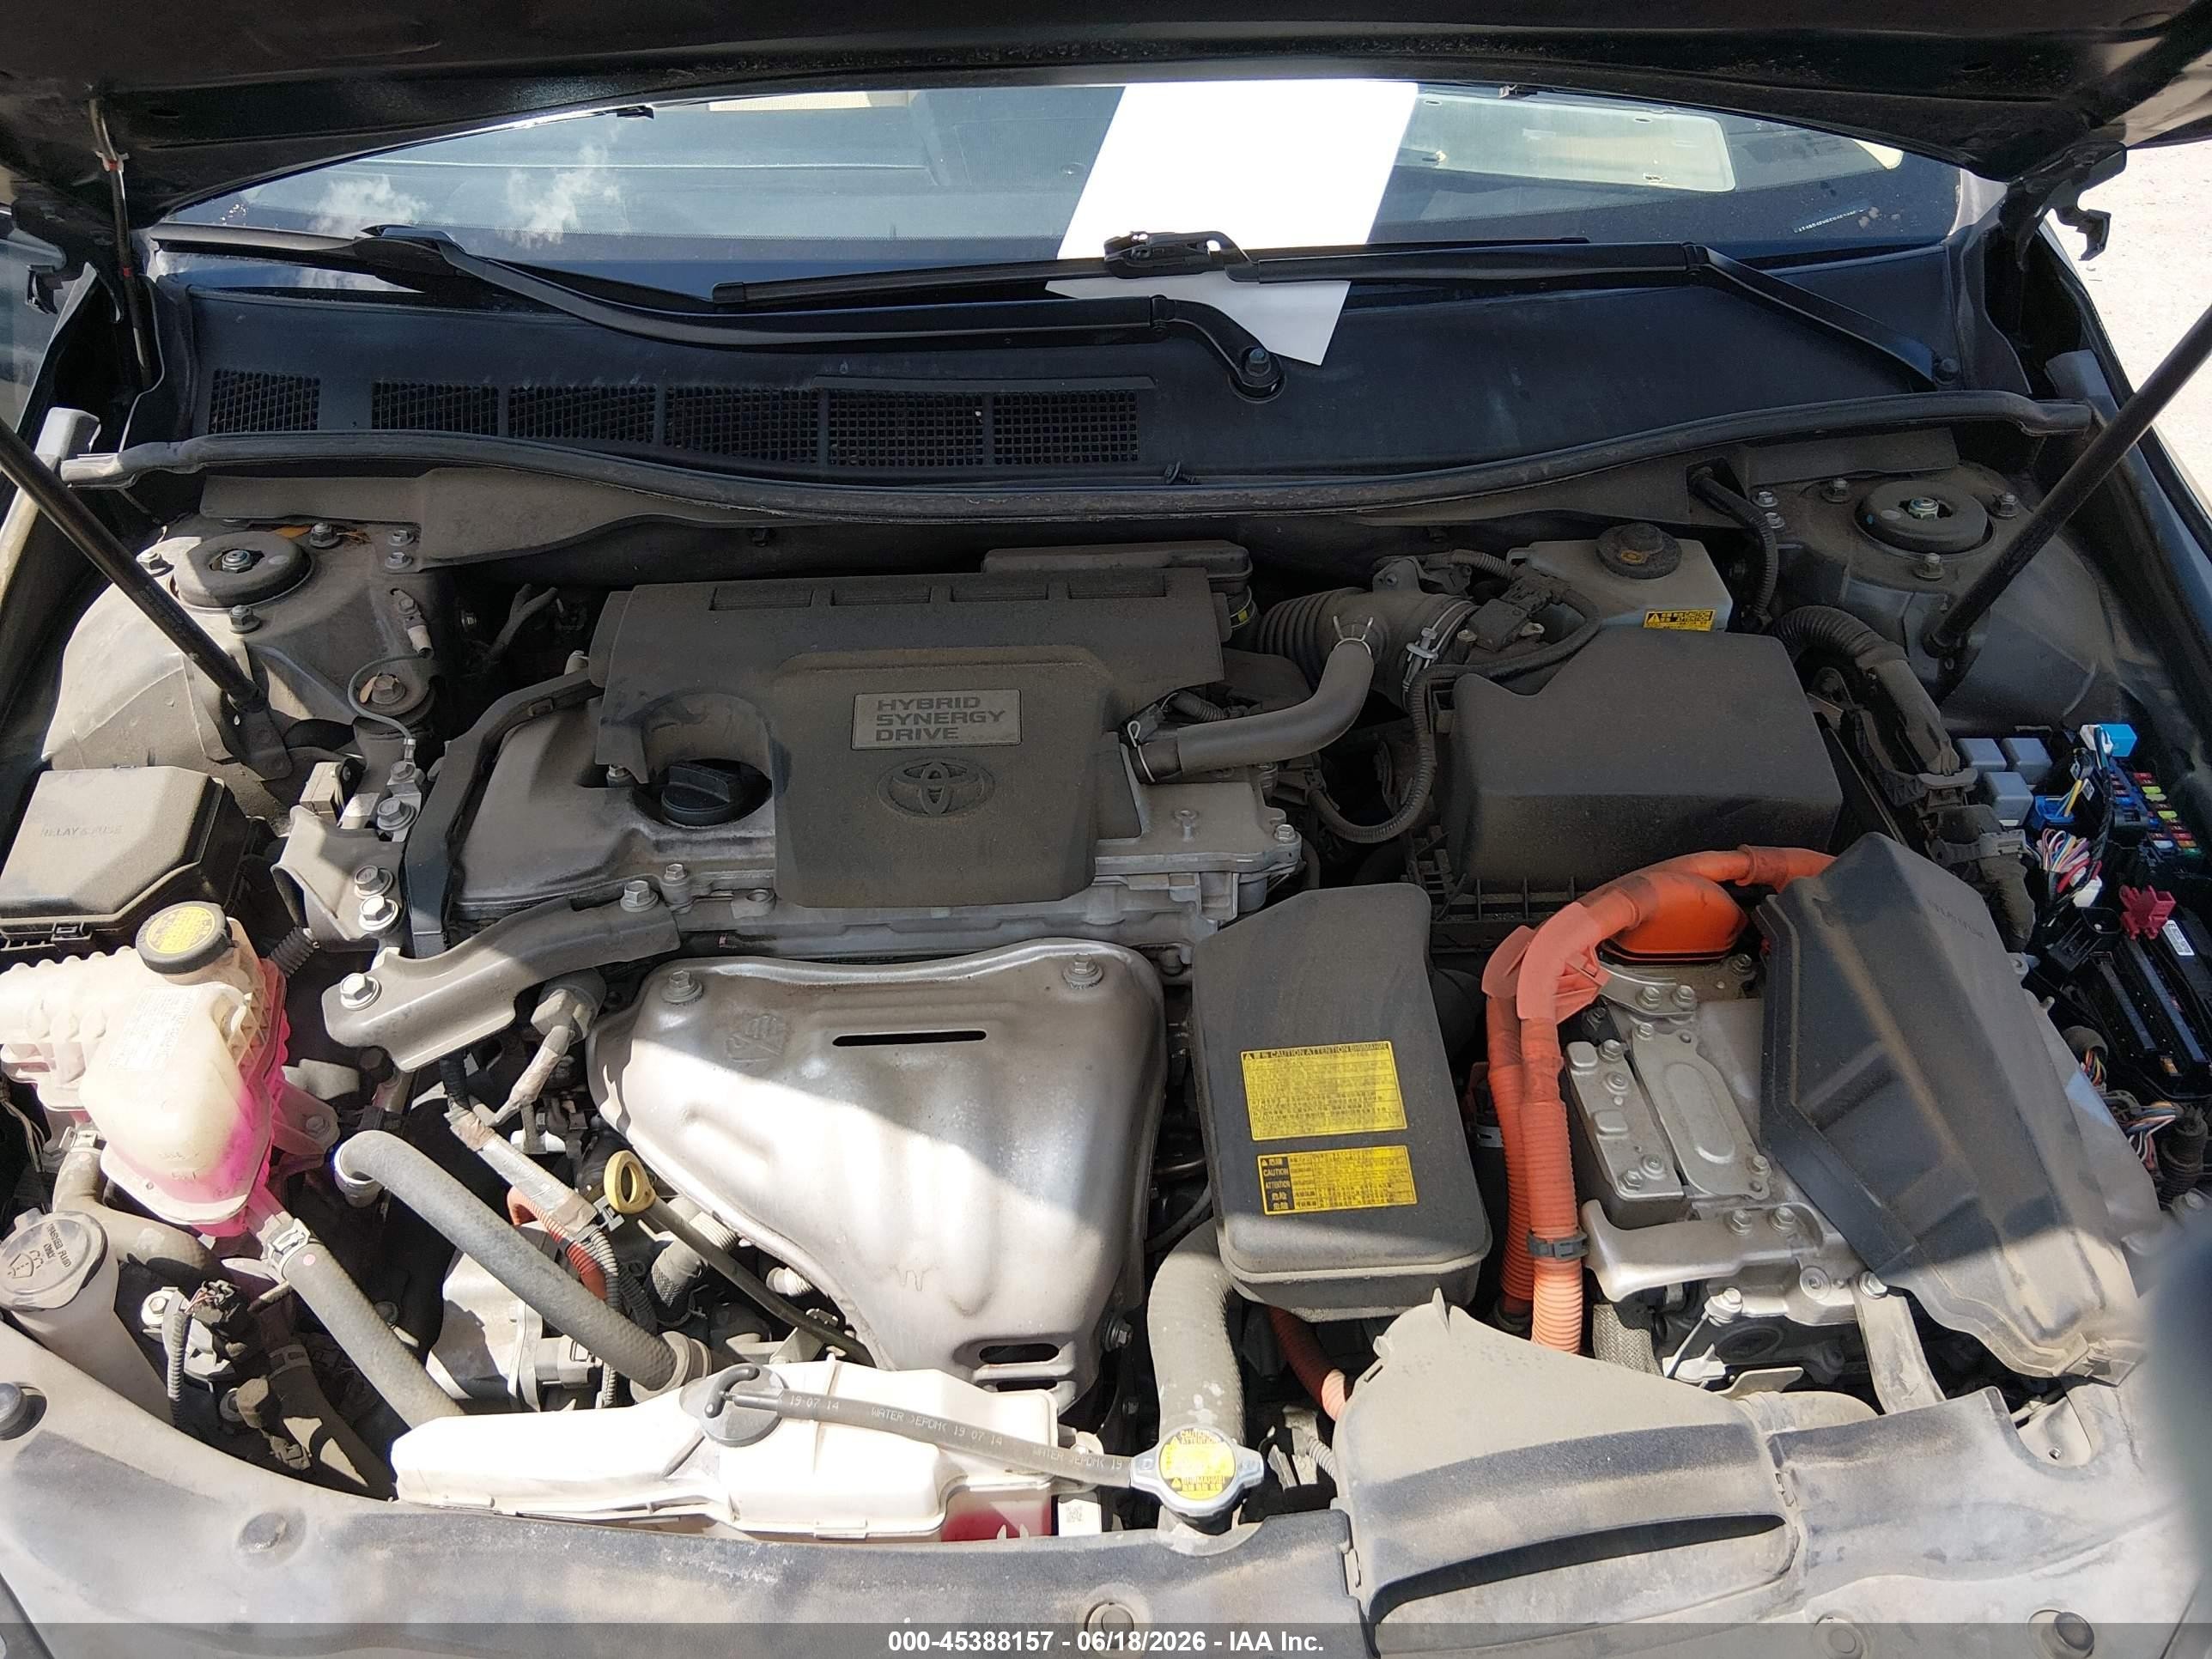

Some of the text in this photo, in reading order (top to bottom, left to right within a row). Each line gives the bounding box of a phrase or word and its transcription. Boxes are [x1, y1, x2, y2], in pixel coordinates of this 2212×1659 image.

[877, 696, 981, 712] HYBRID
[876, 710, 1006, 726] SYNERGY
[876, 726, 959, 742] DRIVE
[1270, 1048, 1305, 1059] CAUTION
[1305, 1045, 1349, 1056] ATTENTION
[1263, 1168, 1289, 1176] CAUTION
[826, 1401, 840, 1411] 14
[871, 1407, 905, 1423] WATER
[953, 1425, 966, 1437] 19
[970, 1430, 985, 1442] 07
